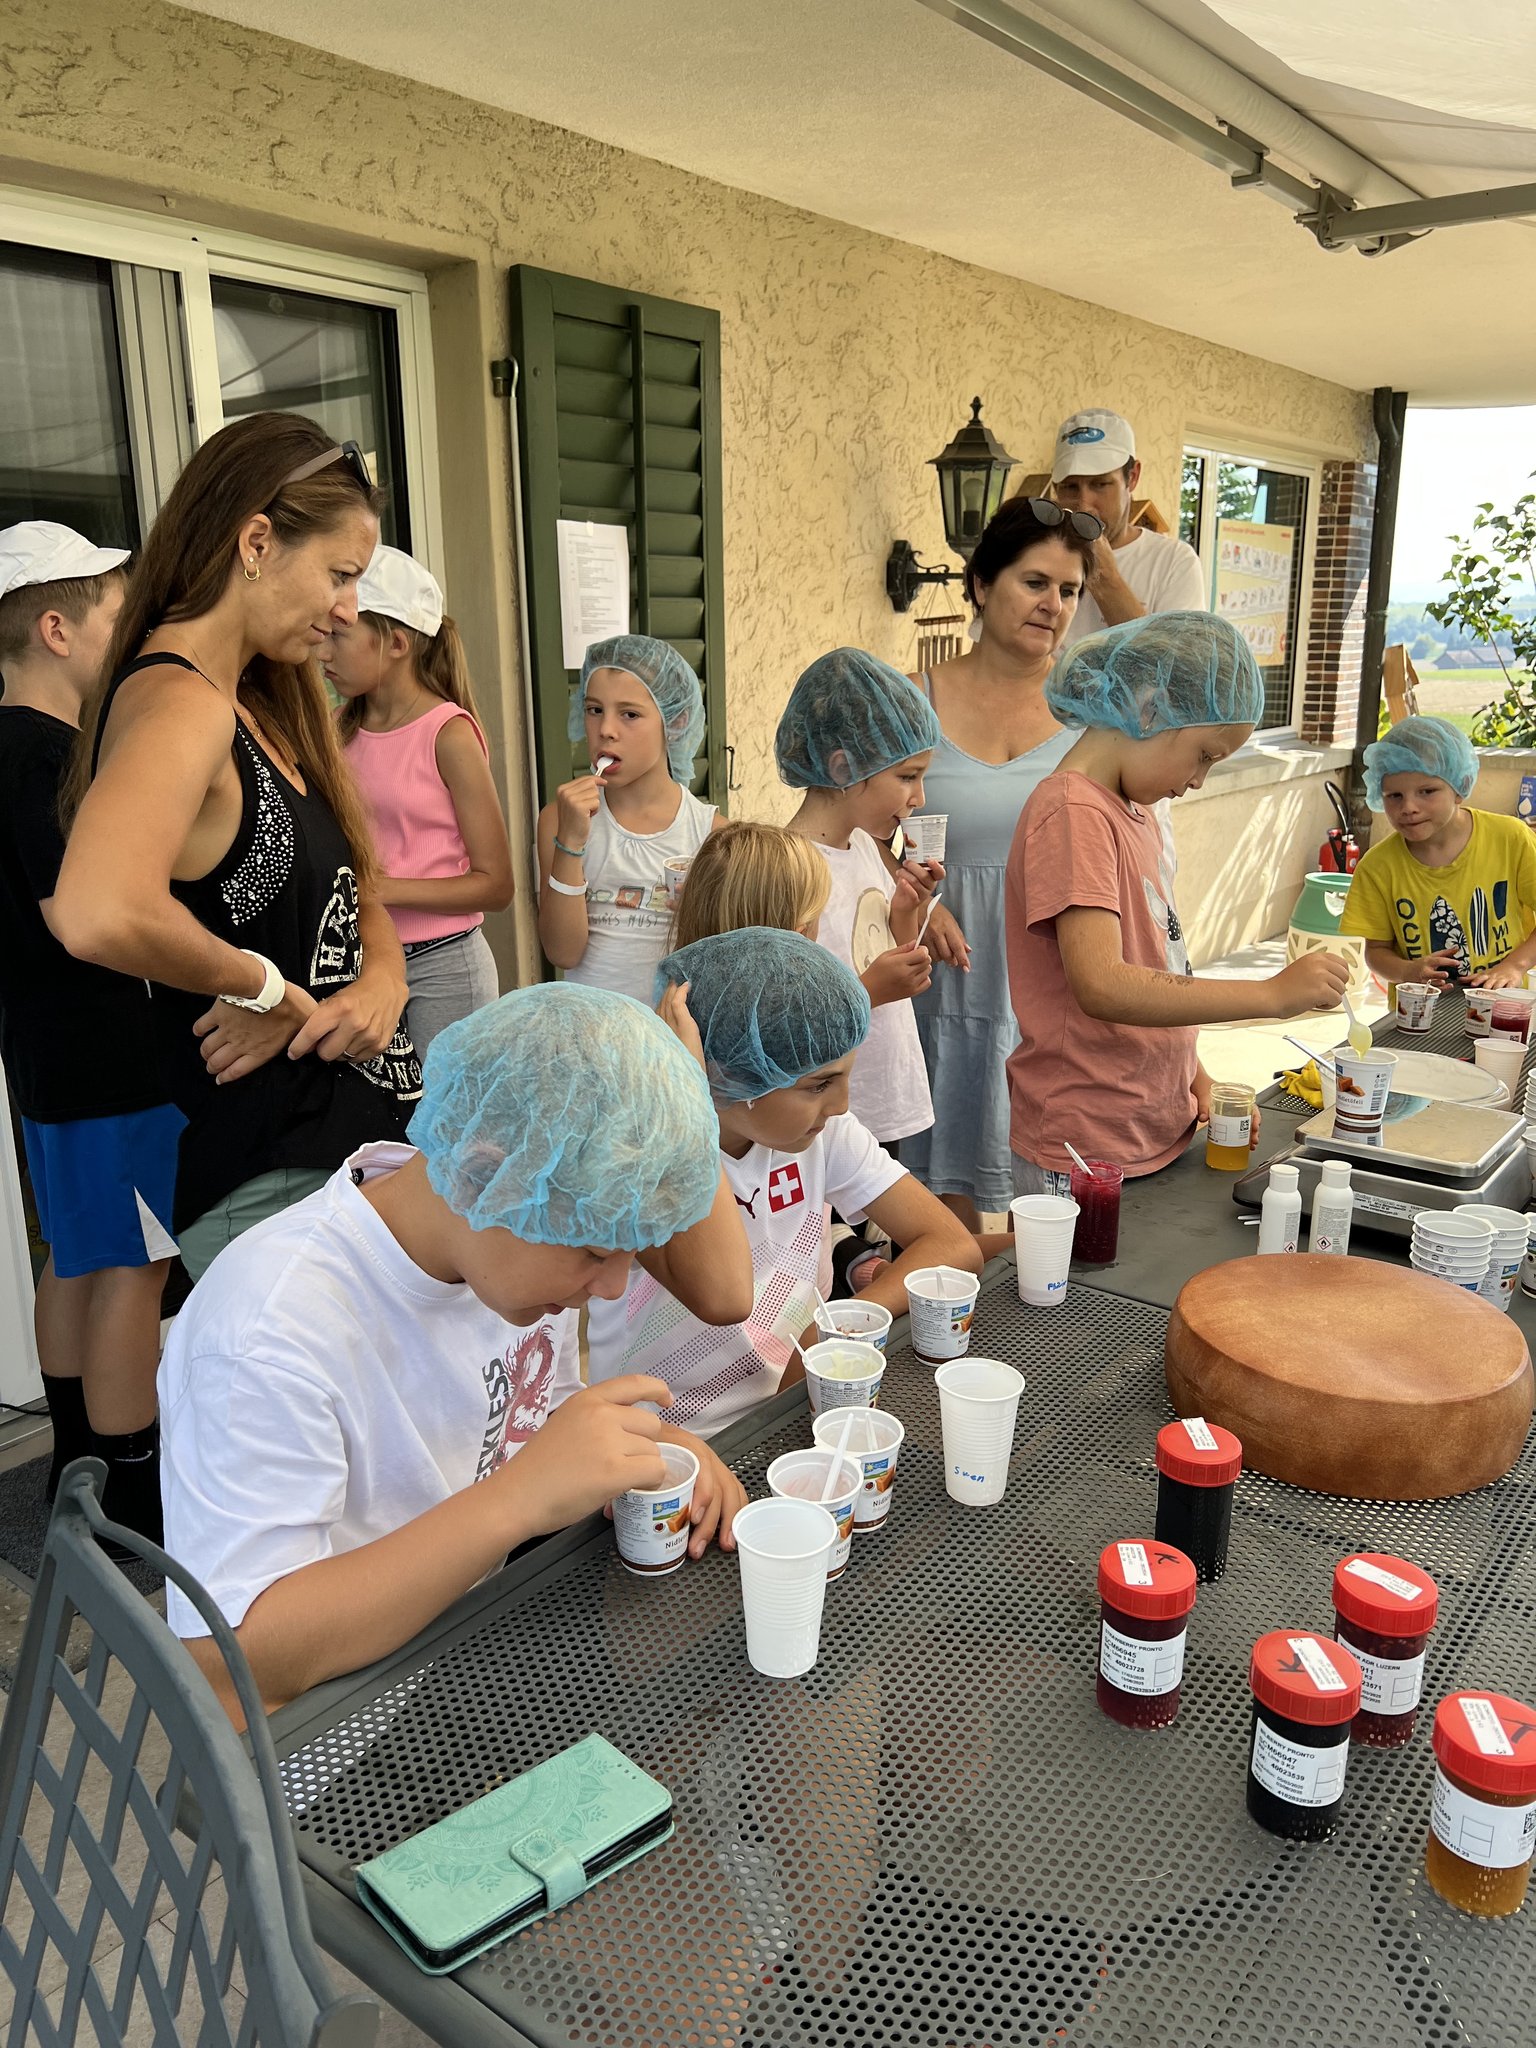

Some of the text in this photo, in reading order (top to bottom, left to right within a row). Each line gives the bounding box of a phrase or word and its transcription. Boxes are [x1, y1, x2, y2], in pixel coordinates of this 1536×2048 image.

[1104, 1628, 1138, 1650] STRAWBERRY
[1104, 1636, 1137, 1659] SCM66945
[1375, 1662, 1401, 1671] LUZERN
[1259, 1736, 1297, 1764] SCM66947
[1286, 1747, 1315, 1759] PRONTO
